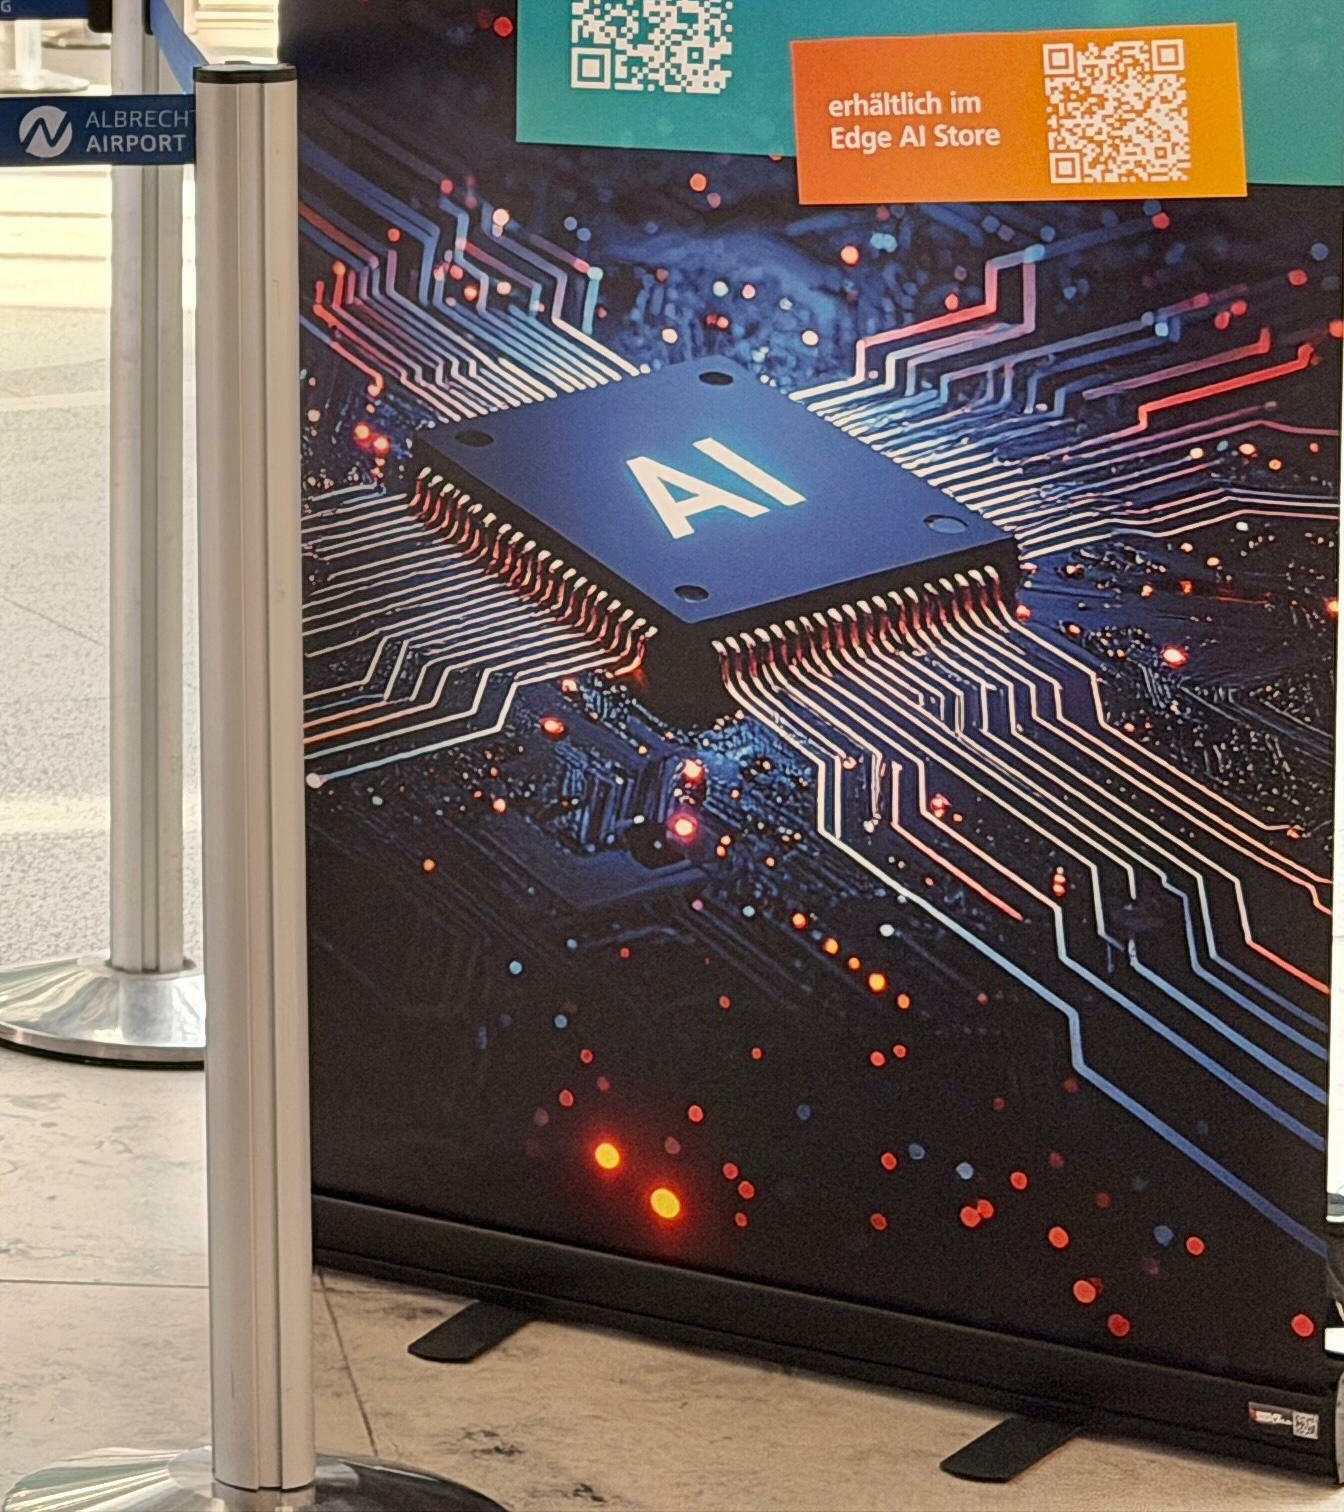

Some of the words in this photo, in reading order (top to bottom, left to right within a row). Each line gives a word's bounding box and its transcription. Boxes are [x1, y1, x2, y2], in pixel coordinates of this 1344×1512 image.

[828, 91, 943, 118] erhältlich
[950, 92, 982, 115] im
[86, 133, 187, 153] AIRPORT
[831, 125, 893, 155] Edge
[899, 125, 926, 148] AI
[934, 124, 1001, 148] Store
[625, 436, 807, 540] AI
